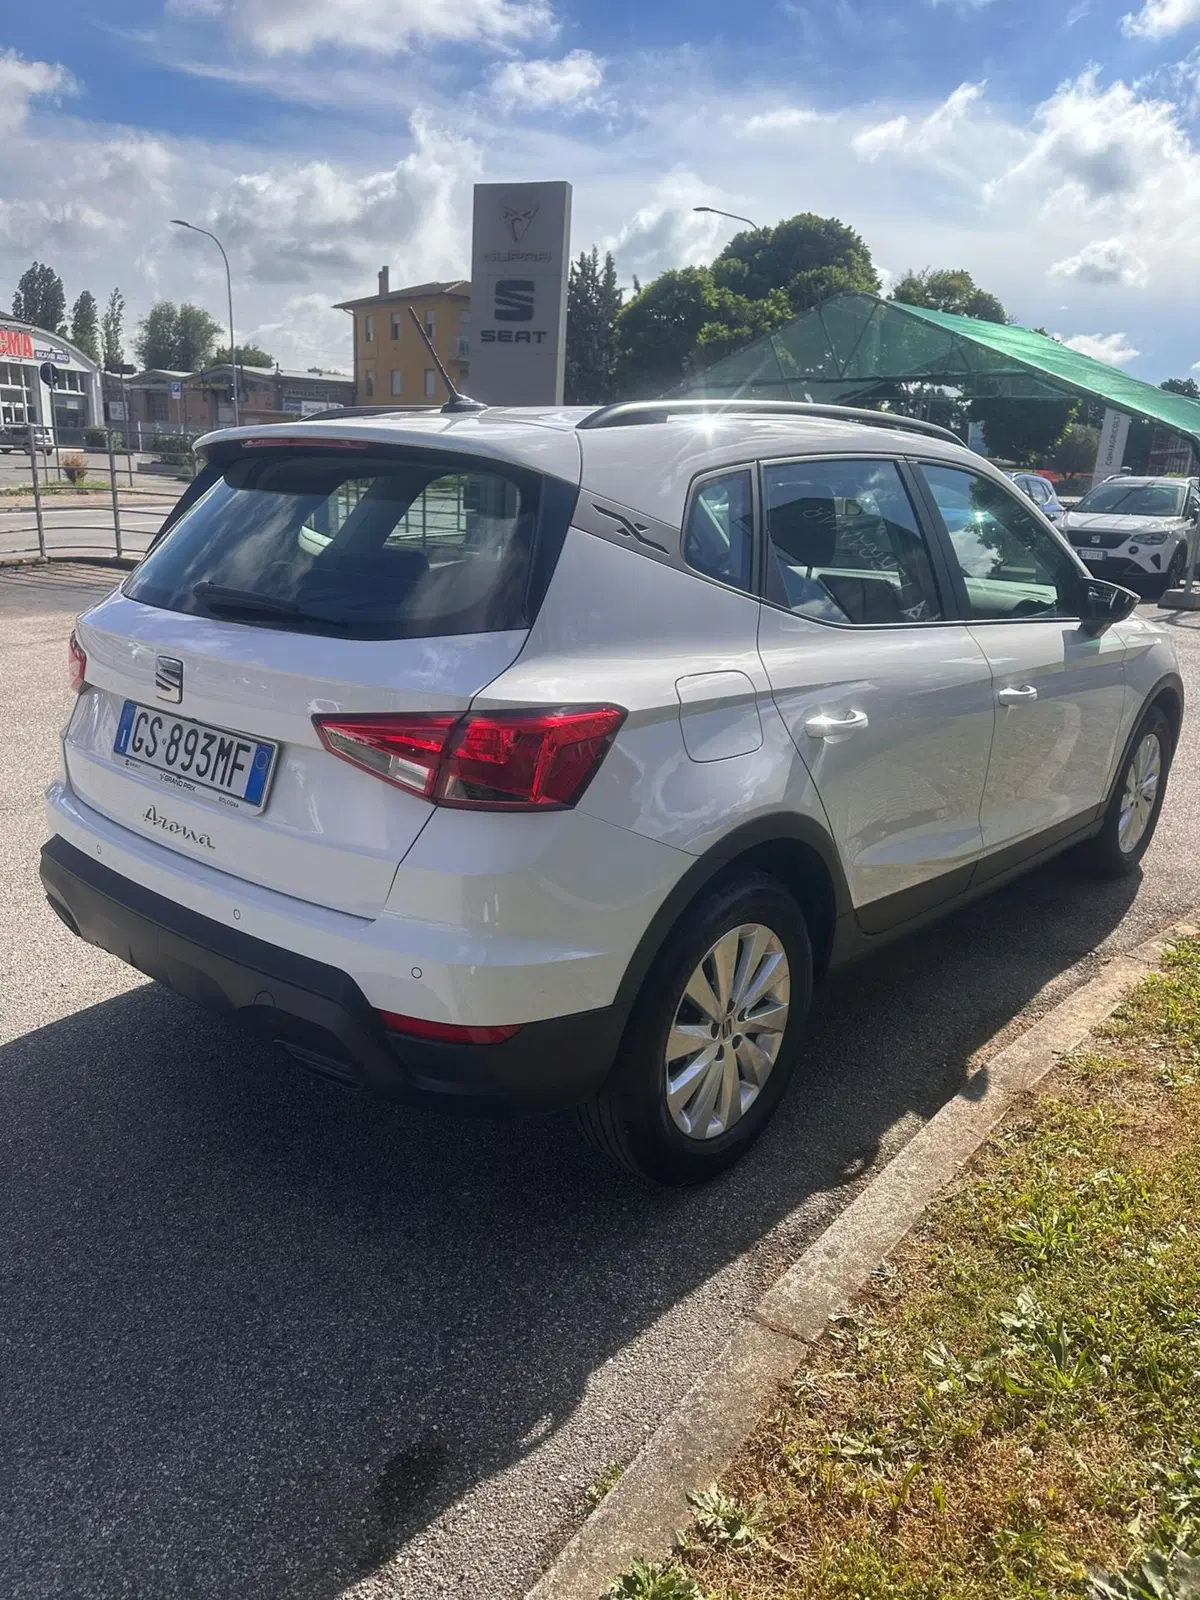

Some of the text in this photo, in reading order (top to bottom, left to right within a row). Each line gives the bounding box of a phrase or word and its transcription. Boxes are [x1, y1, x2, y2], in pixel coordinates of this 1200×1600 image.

[480, 329, 547, 344] SEAT
[164, 774, 183, 787] GRAND
[218, 796, 239, 809] BOLOGNA
[143, 804, 216, 850] Arona
